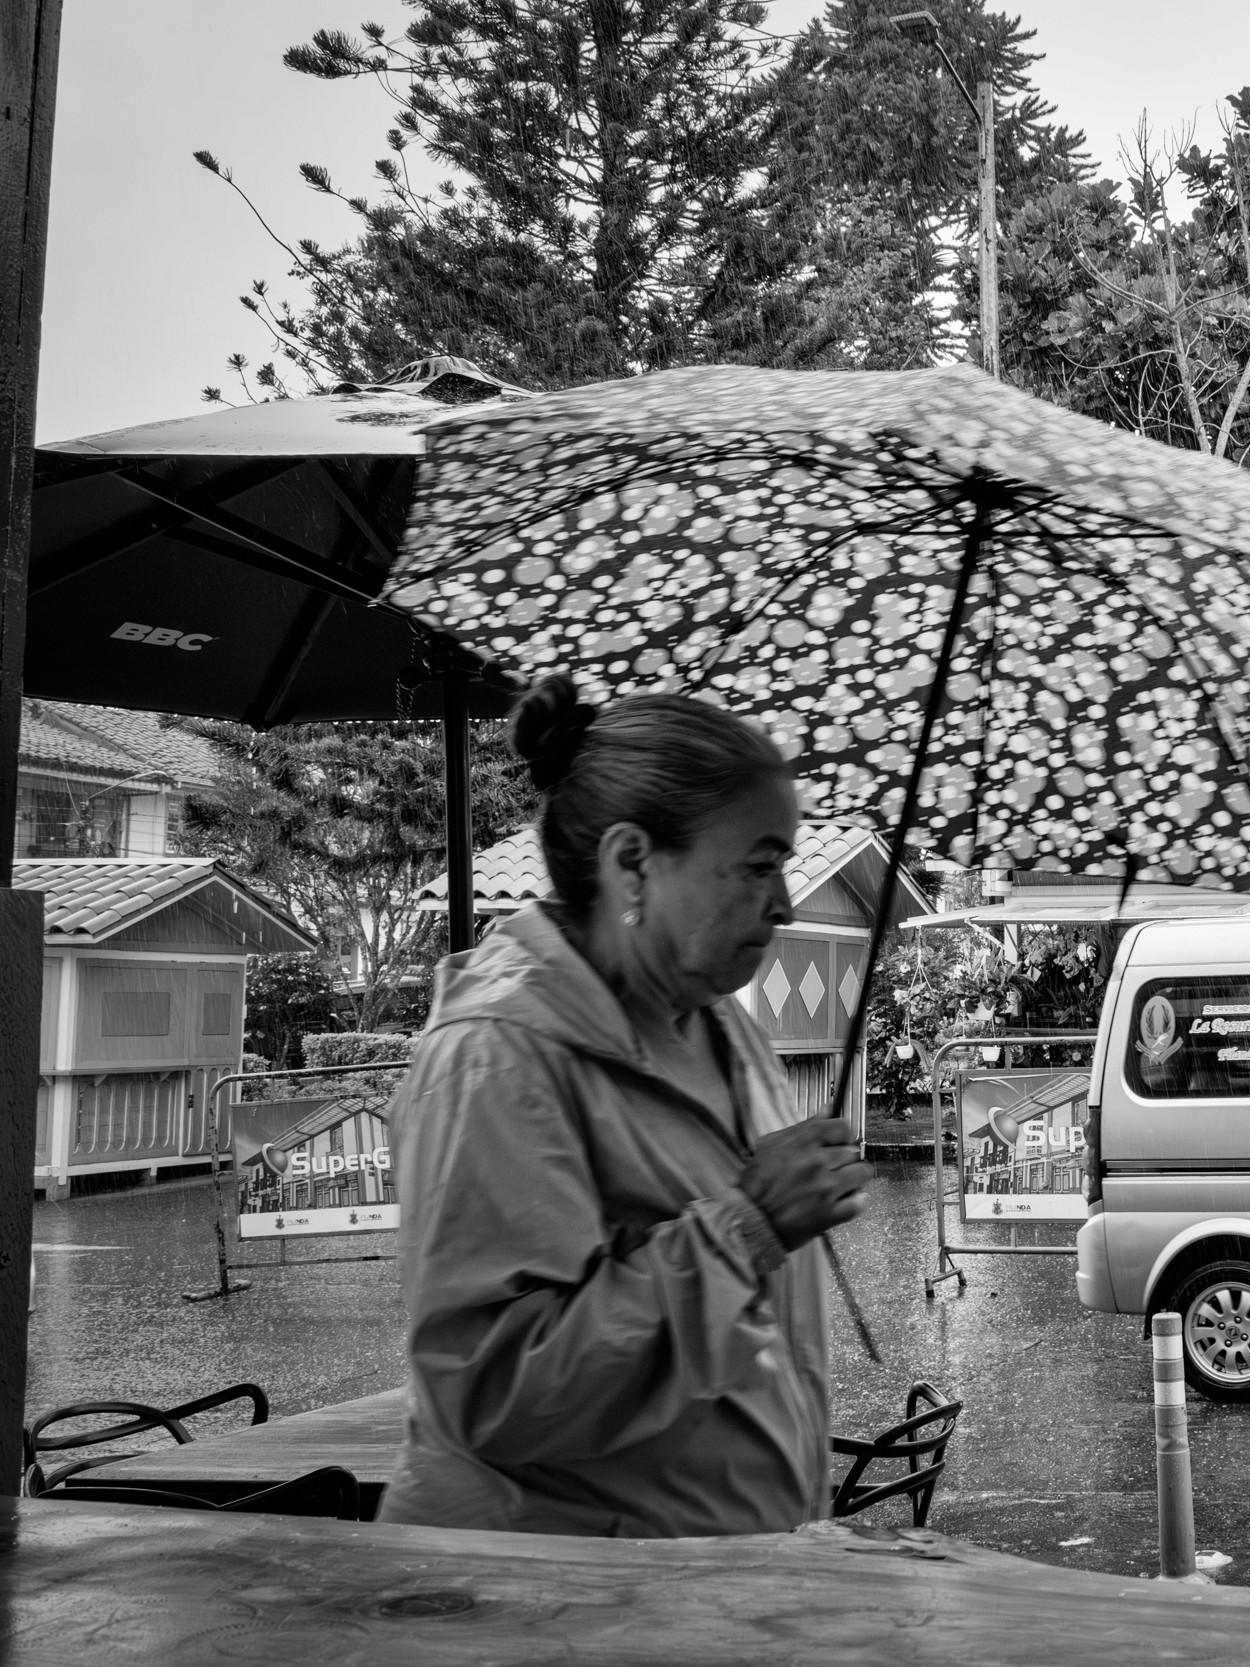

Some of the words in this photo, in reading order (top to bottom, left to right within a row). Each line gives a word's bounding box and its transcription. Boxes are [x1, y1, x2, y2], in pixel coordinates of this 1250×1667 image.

[109, 621, 214, 651] BBC
[1189, 1018, 1211, 1034] La
[1023, 1120, 1087, 1153] Sup
[290, 1146, 391, 1178] SuperG
